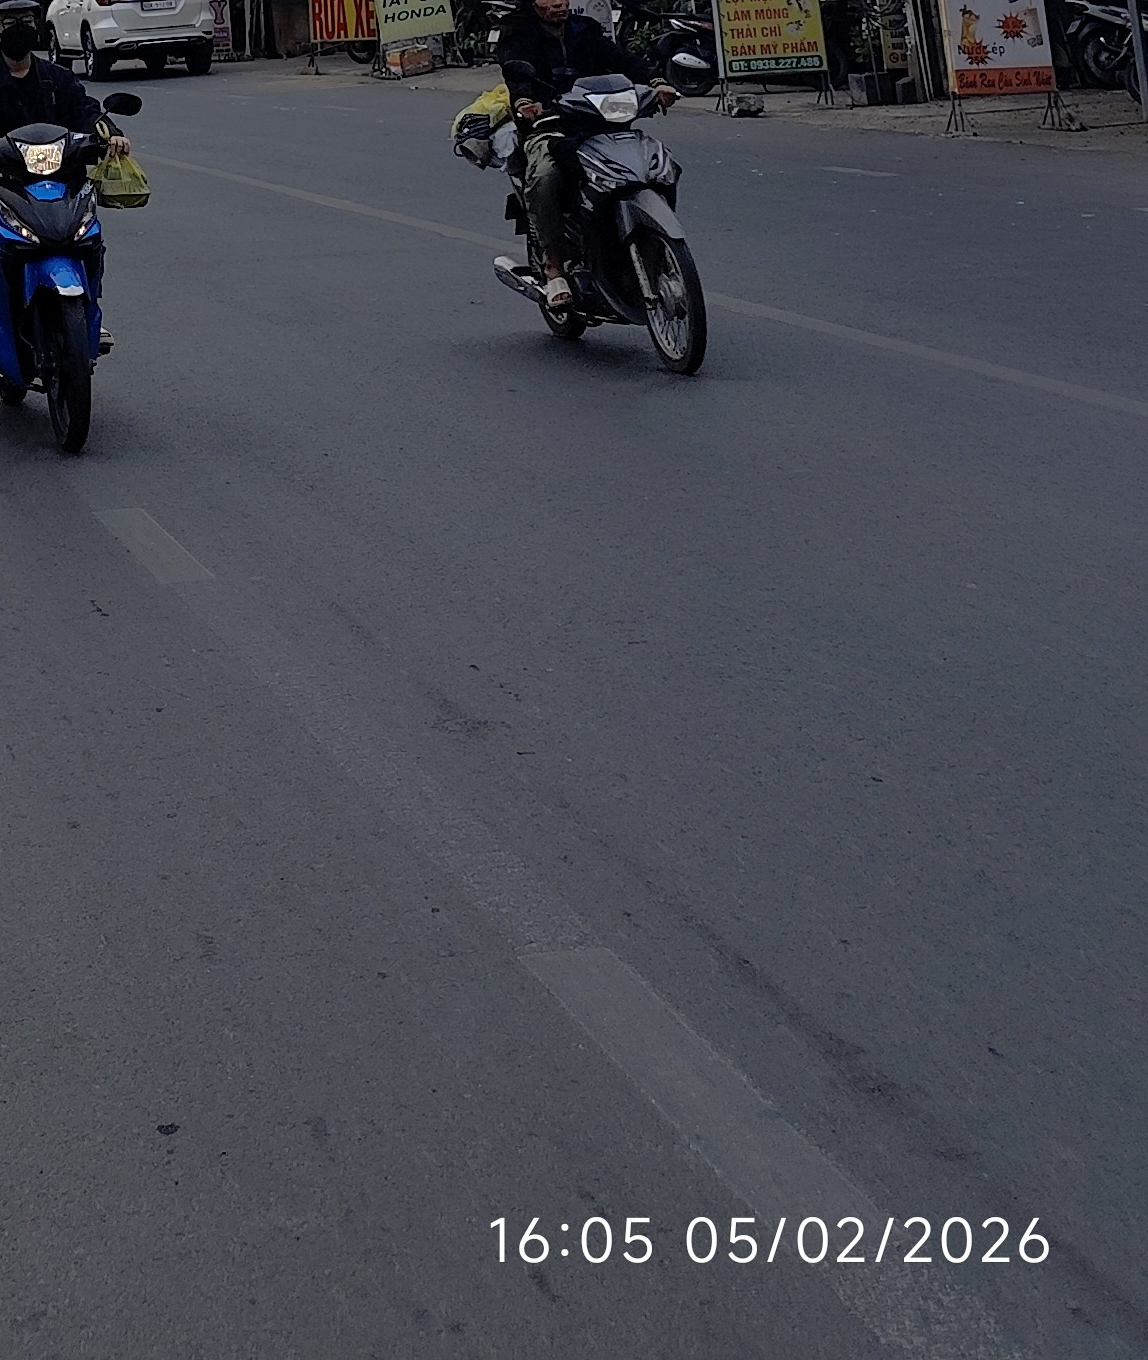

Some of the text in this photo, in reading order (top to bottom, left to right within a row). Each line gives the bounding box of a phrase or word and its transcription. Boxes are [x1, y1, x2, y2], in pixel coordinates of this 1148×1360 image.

[384, 4, 447, 24] HONDA
[754, 6, 790, 21] MÓNG
[730, 42, 757, 57] BÁN
[782, 36, 819, 54] PHẨM
[991, 42, 1005, 57] ép
